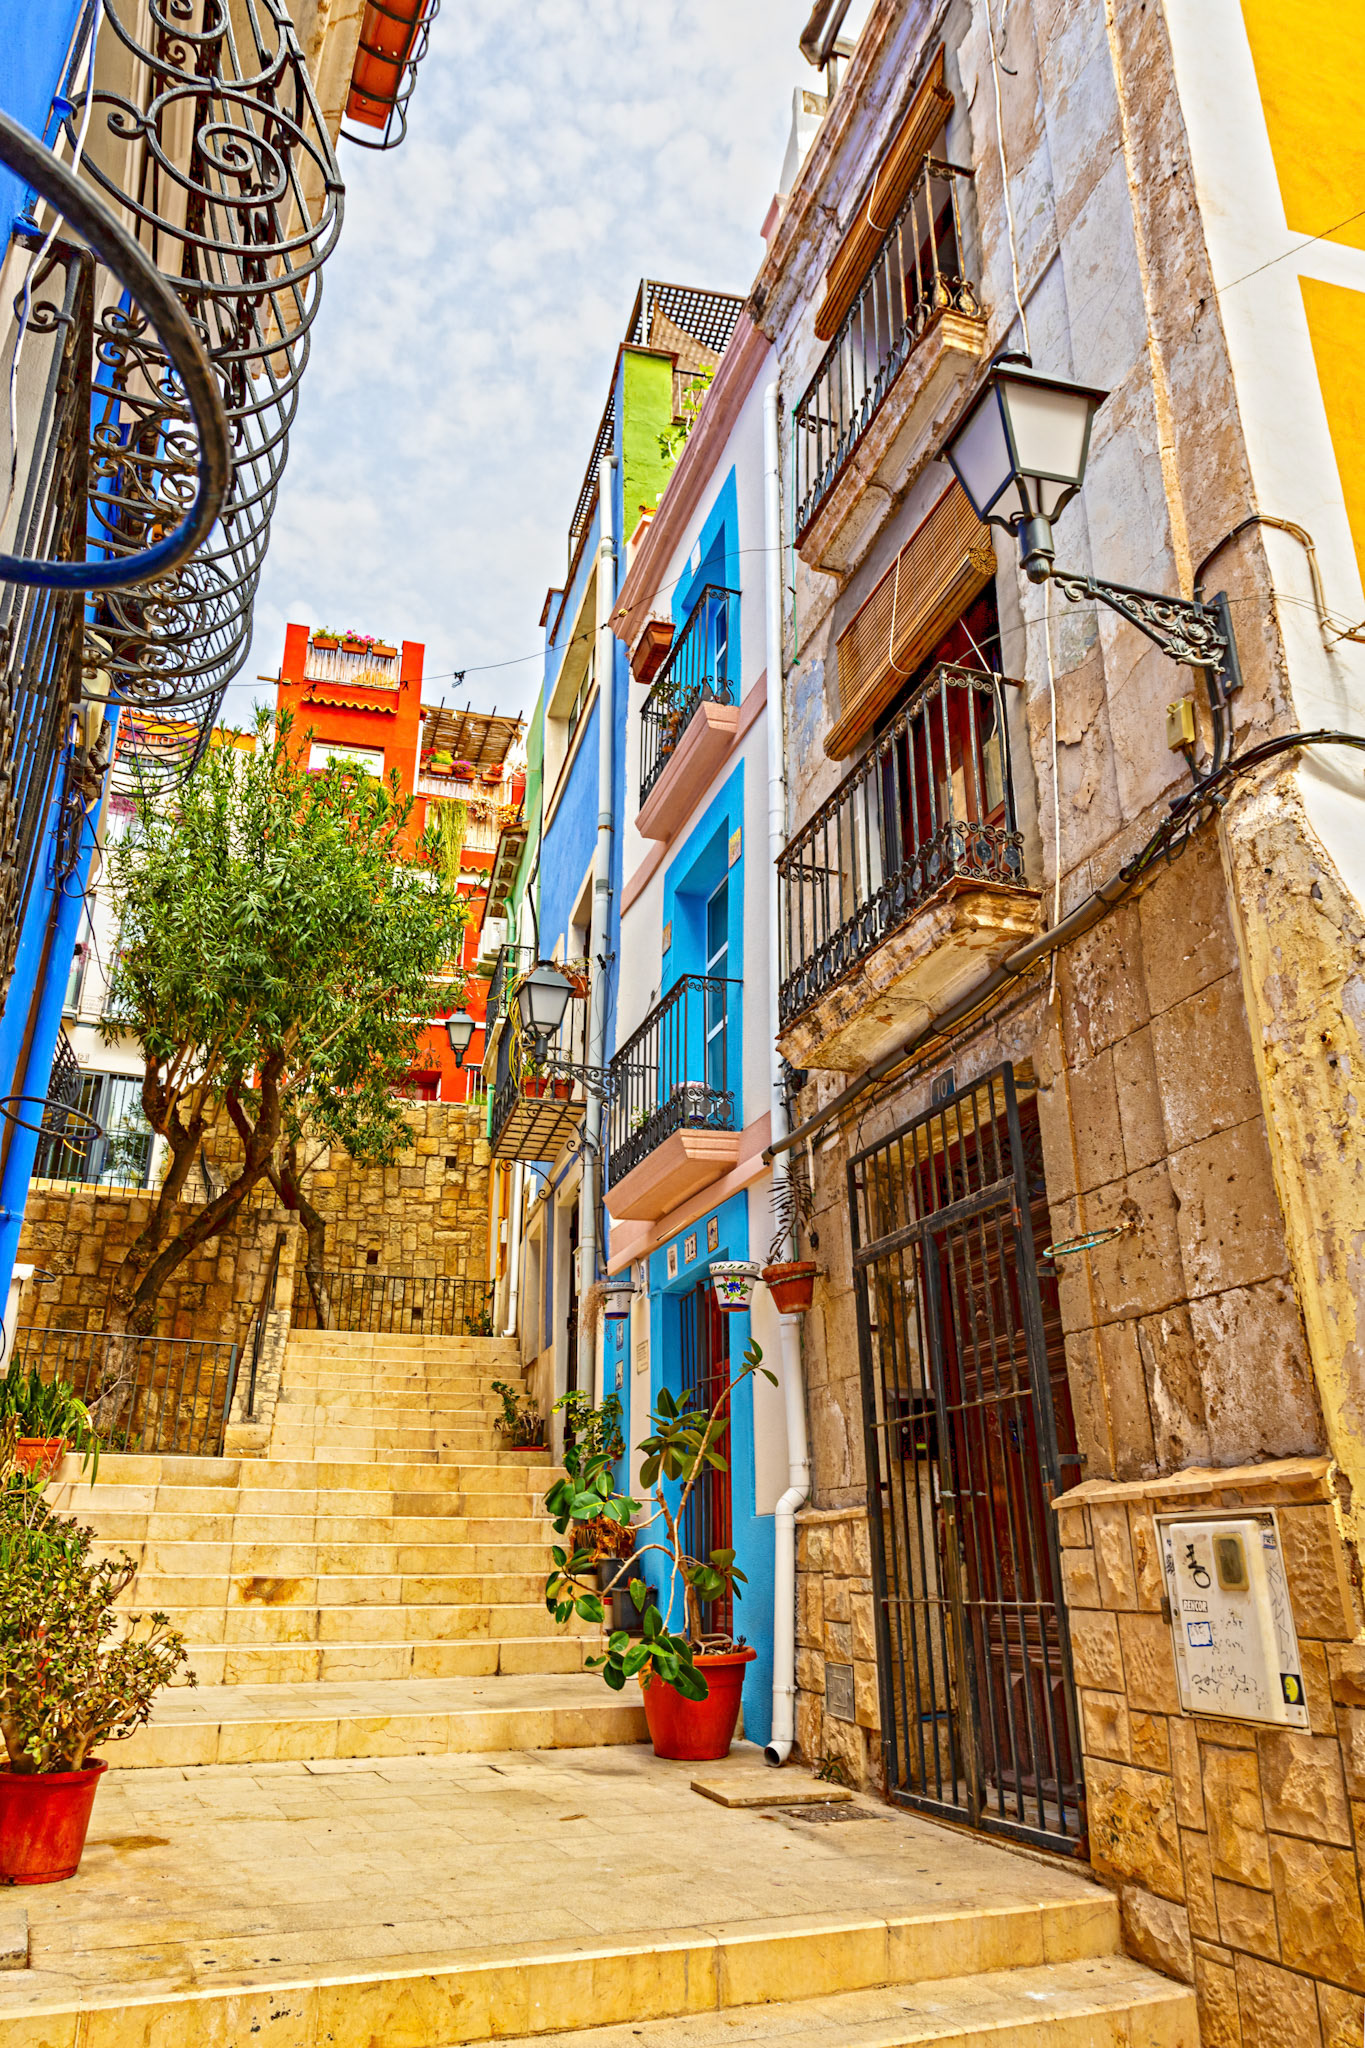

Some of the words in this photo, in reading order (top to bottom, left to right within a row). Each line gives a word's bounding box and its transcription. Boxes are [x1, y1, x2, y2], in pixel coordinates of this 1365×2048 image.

[936, 1078, 948, 1102] 10
[687, 1240, 694, 1257] 12
[1183, 1600, 1208, 1612] RENCOR
